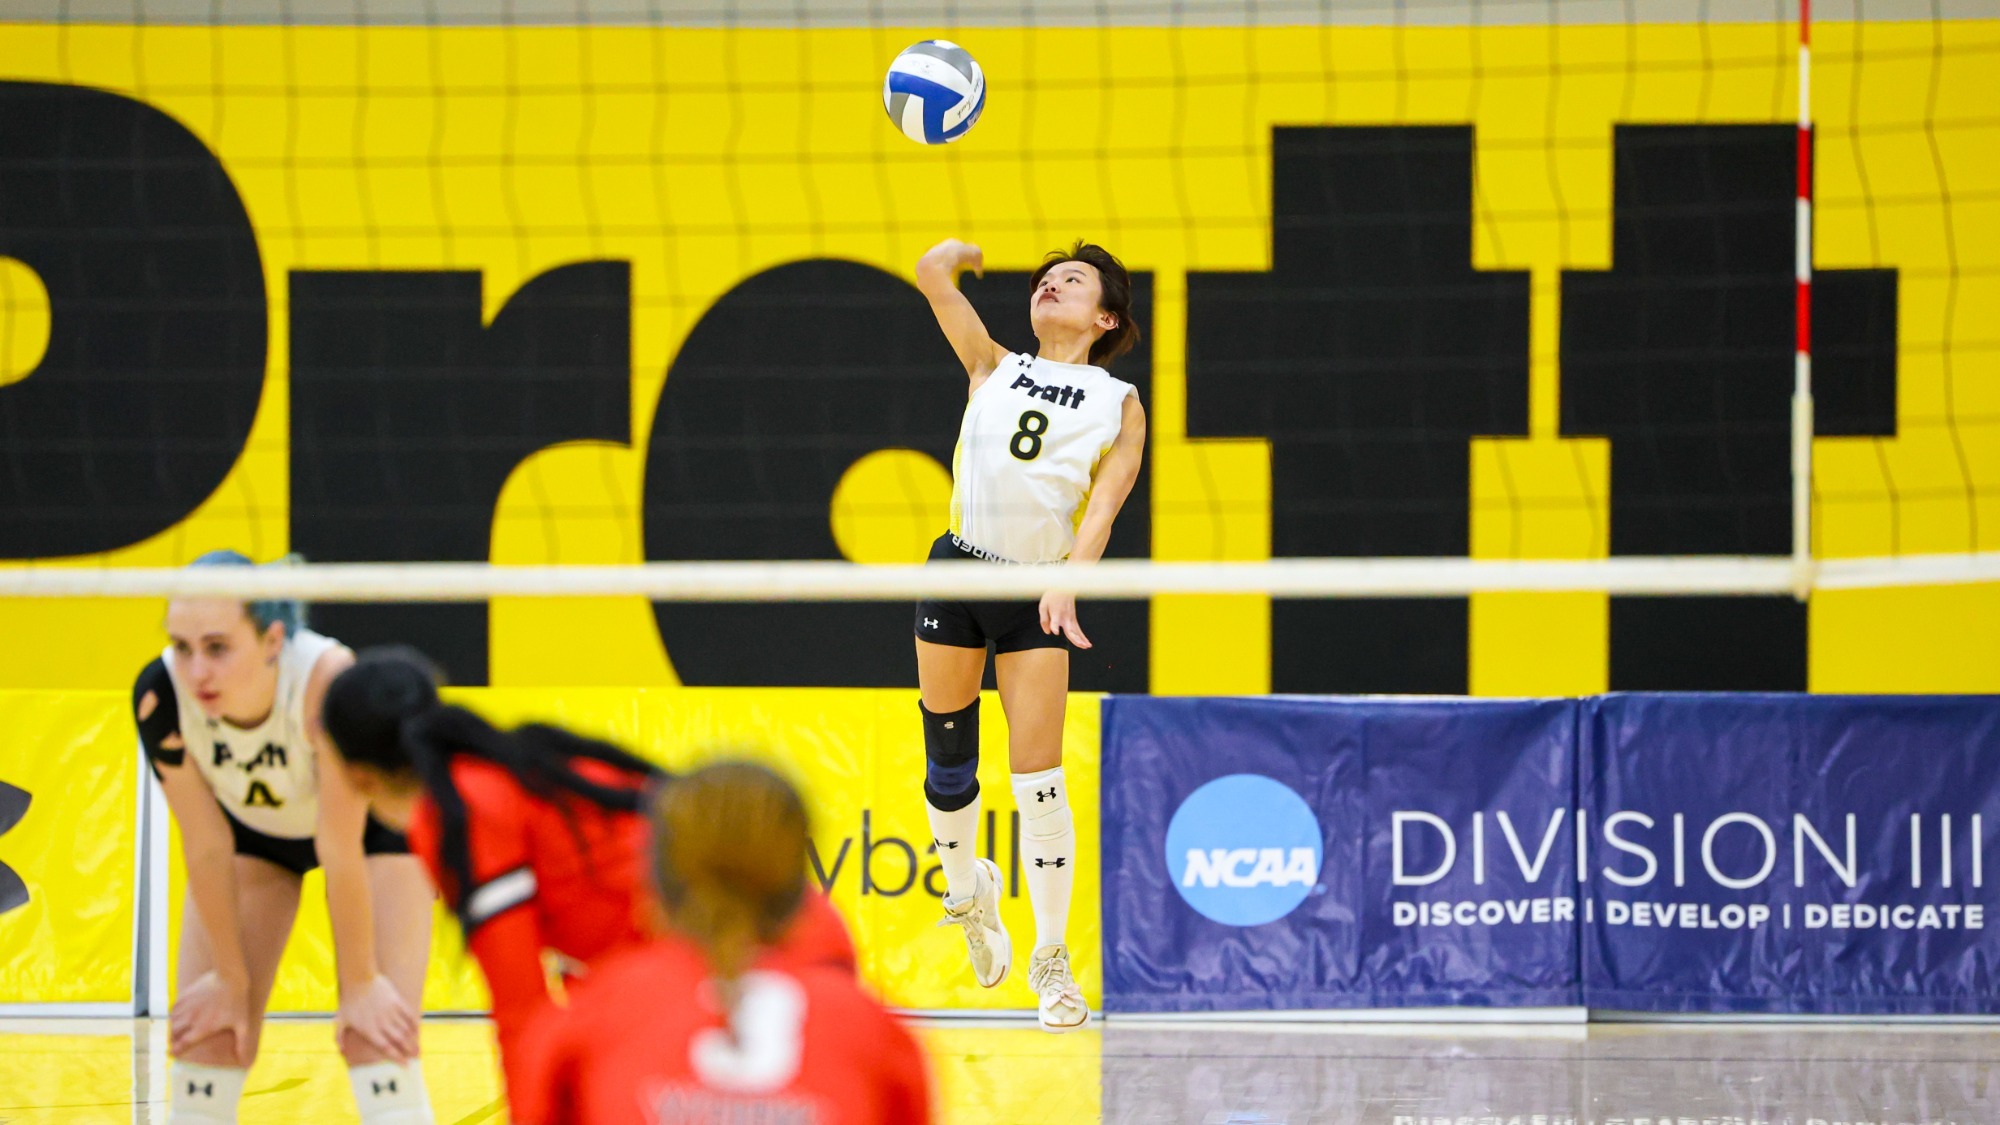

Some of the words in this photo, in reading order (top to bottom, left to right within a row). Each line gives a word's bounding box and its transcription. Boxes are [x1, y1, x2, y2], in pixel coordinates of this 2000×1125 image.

[1009, 373, 1086, 409] Pratt
[1009, 409, 1049, 461] 8
[1182, 847, 1318, 887] NCAA
[1392, 808, 1857, 889] DIVISION
[1911, 813, 1982, 888] III
[1393, 897, 1575, 926] DISCOVER
[1607, 902, 1770, 929] DEVELOP
[1805, 904, 1984, 929] DEDICATE
